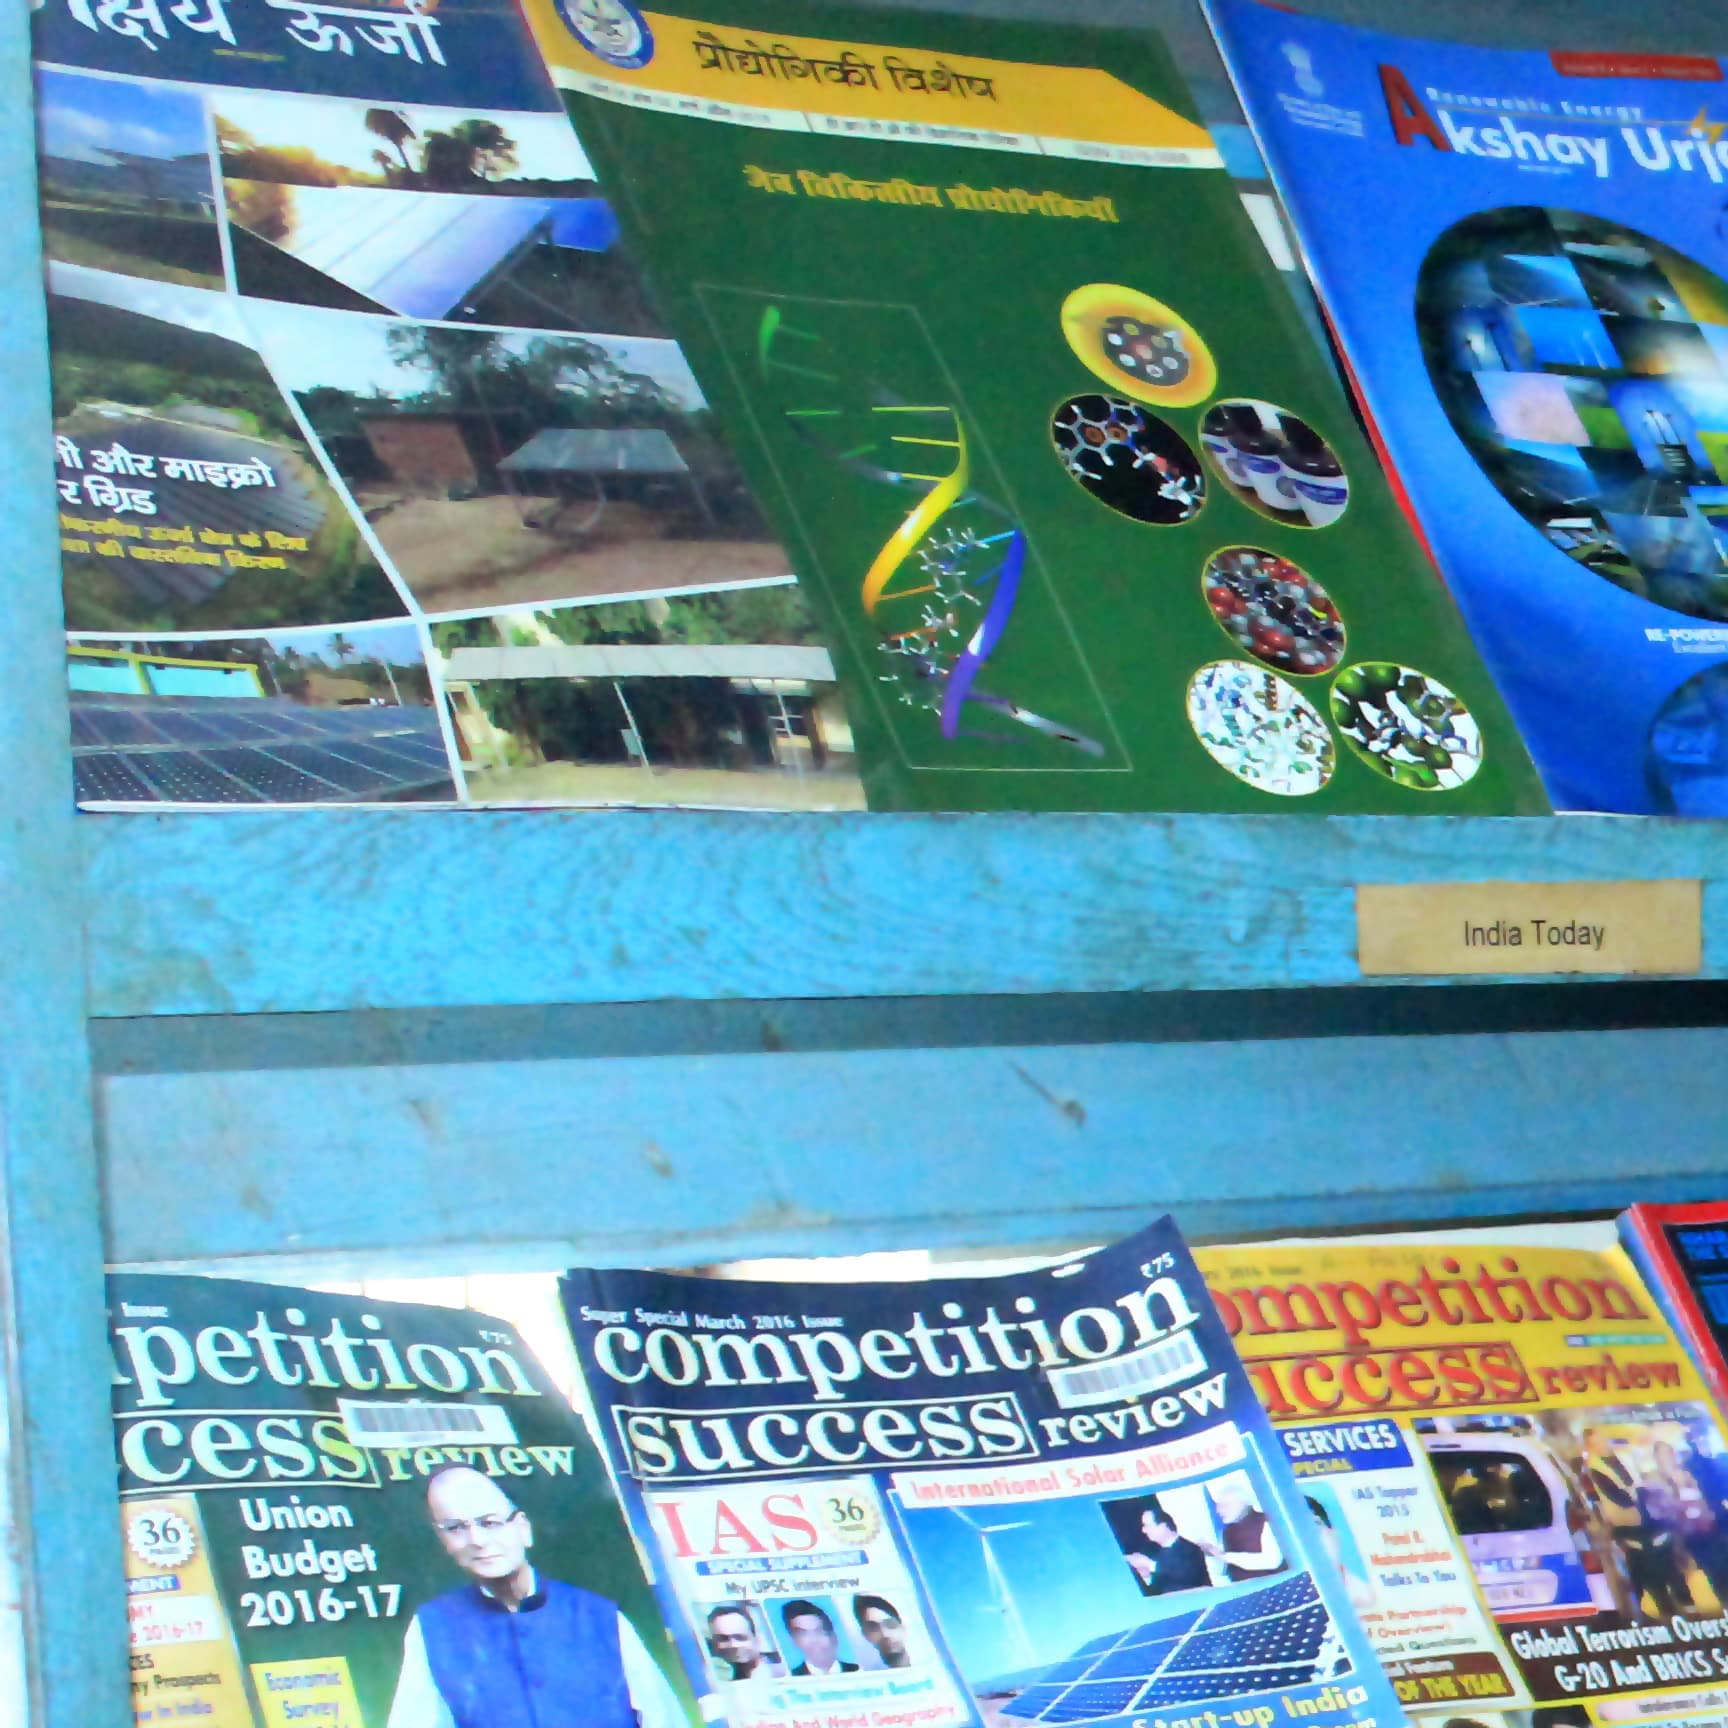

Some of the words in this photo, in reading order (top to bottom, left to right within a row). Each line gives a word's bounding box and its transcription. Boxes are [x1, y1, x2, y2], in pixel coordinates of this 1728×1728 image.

[692, 31, 879, 92] प्रौद्योगिकी
[884, 55, 998, 101] विशेष
[1378, 64, 1610, 178] Akshay
[1464, 920, 1522, 947] India
[1531, 919, 1606, 951] Today
[1209, 1256, 1650, 1350] ompetition
[112, 1308, 542, 1408] petition
[594, 1277, 1200, 1400] competition
[1537, 1353, 1683, 1396] review
[627, 1400, 1026, 1474] success
[1039, 1373, 1229, 1447] review
[1283, 1423, 1398, 1458] SERVICES
[910, 1471, 1054, 1501] International
[1066, 1463, 1126, 1490] Solar
[1135, 1443, 1229, 1478] Alliance
[1294, 1457, 1353, 1475] PECIAL
[139, 1517, 182, 1547] 36
[239, 1496, 354, 1532] Union
[655, 1493, 819, 1558] IAS
[828, 1497, 865, 1524] 36
[241, 1538, 379, 1584] Budget
[239, 1583, 402, 1627] 2016-17
[1510, 1625, 1579, 1661] Global
[1574, 1619, 1672, 1654] Terrorism
[1553, 1662, 1610, 1693] G-20
[1610, 1655, 1653, 1688] And
[1652, 1650, 1715, 1681] BRICS
[1281, 1685, 1370, 1719] India
